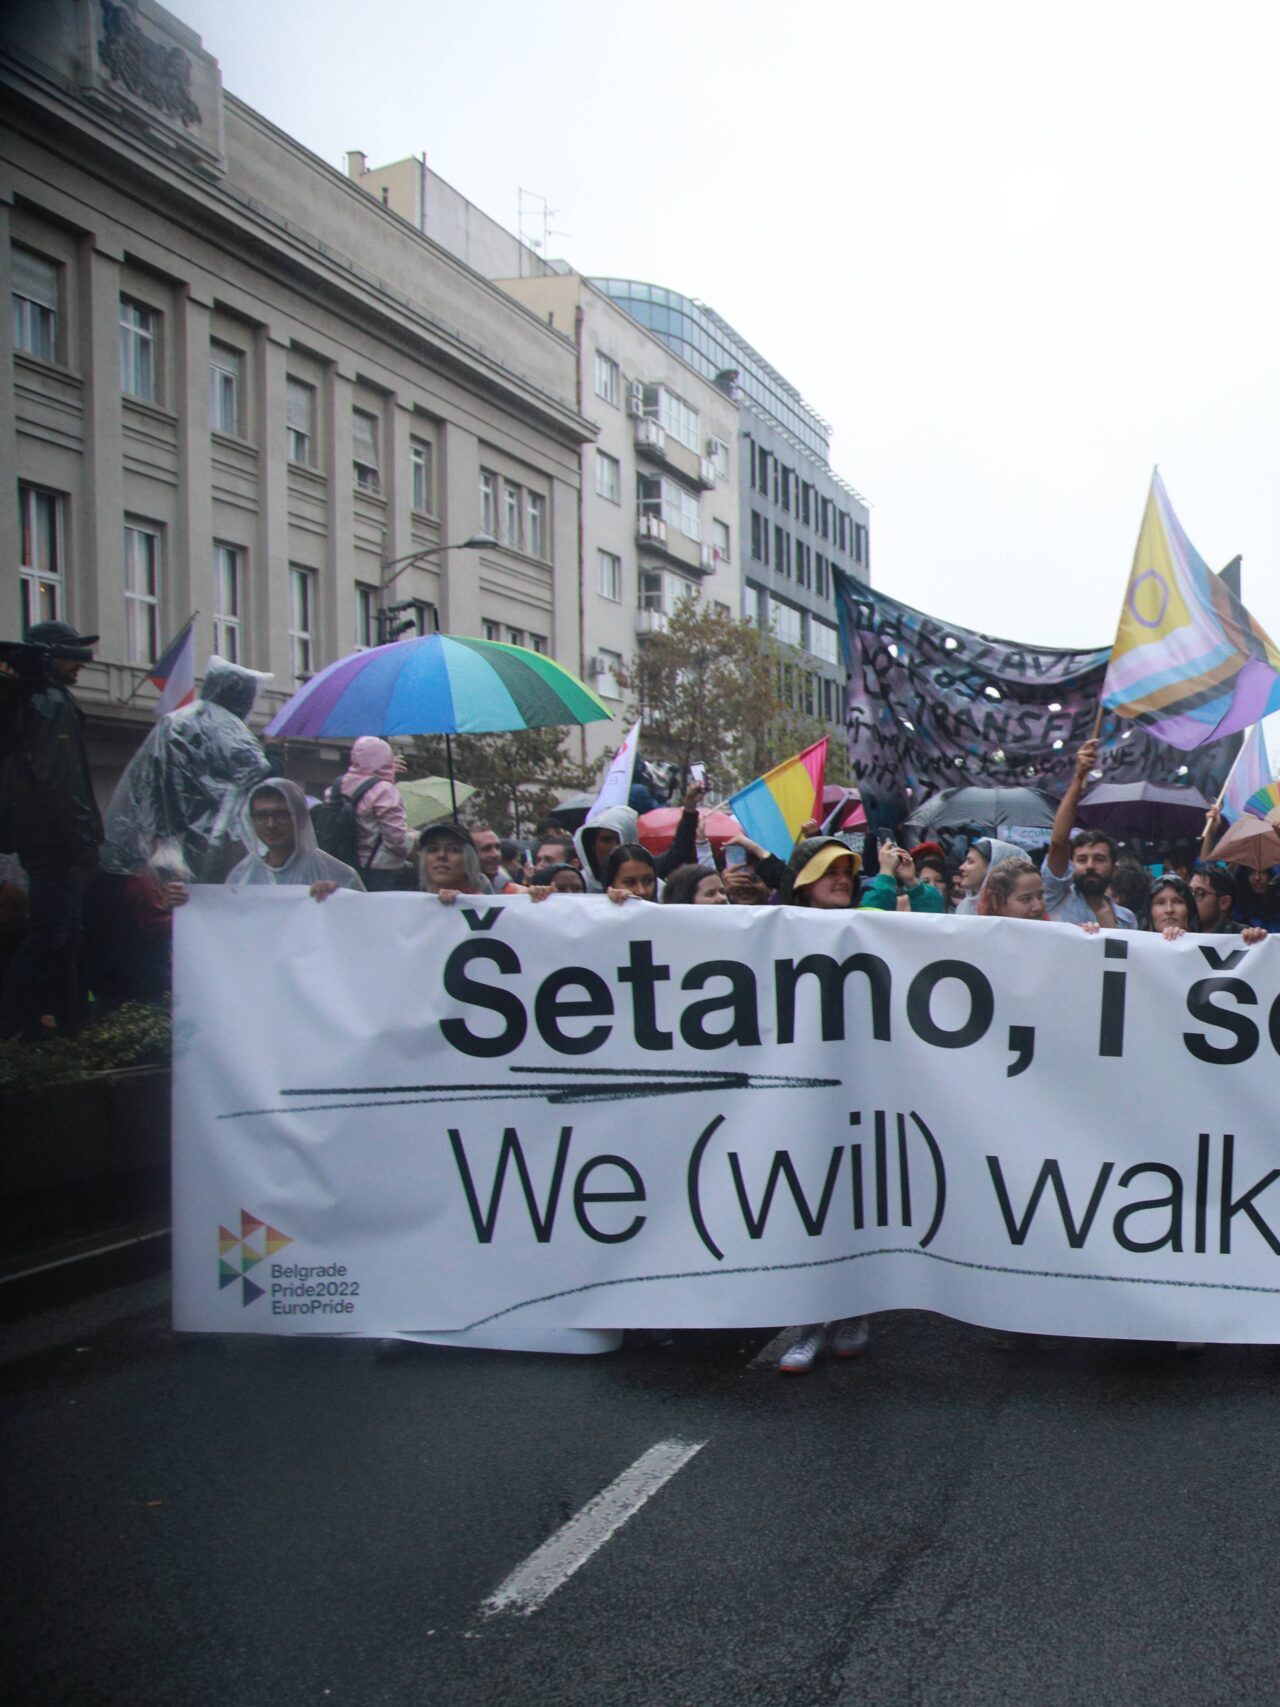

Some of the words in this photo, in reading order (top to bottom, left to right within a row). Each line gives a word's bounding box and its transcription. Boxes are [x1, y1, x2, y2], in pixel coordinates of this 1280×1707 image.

[438, 906, 1036, 1078] Šetamo,
[1099, 937, 1128, 1058] i
[446, 1126, 649, 1245] We
[686, 1109, 948, 1262] (will)
[270, 1262, 348, 1281] Belgrade
[270, 1281, 361, 1298] Pride2022
[271, 1299, 355, 1315] EuroPride
